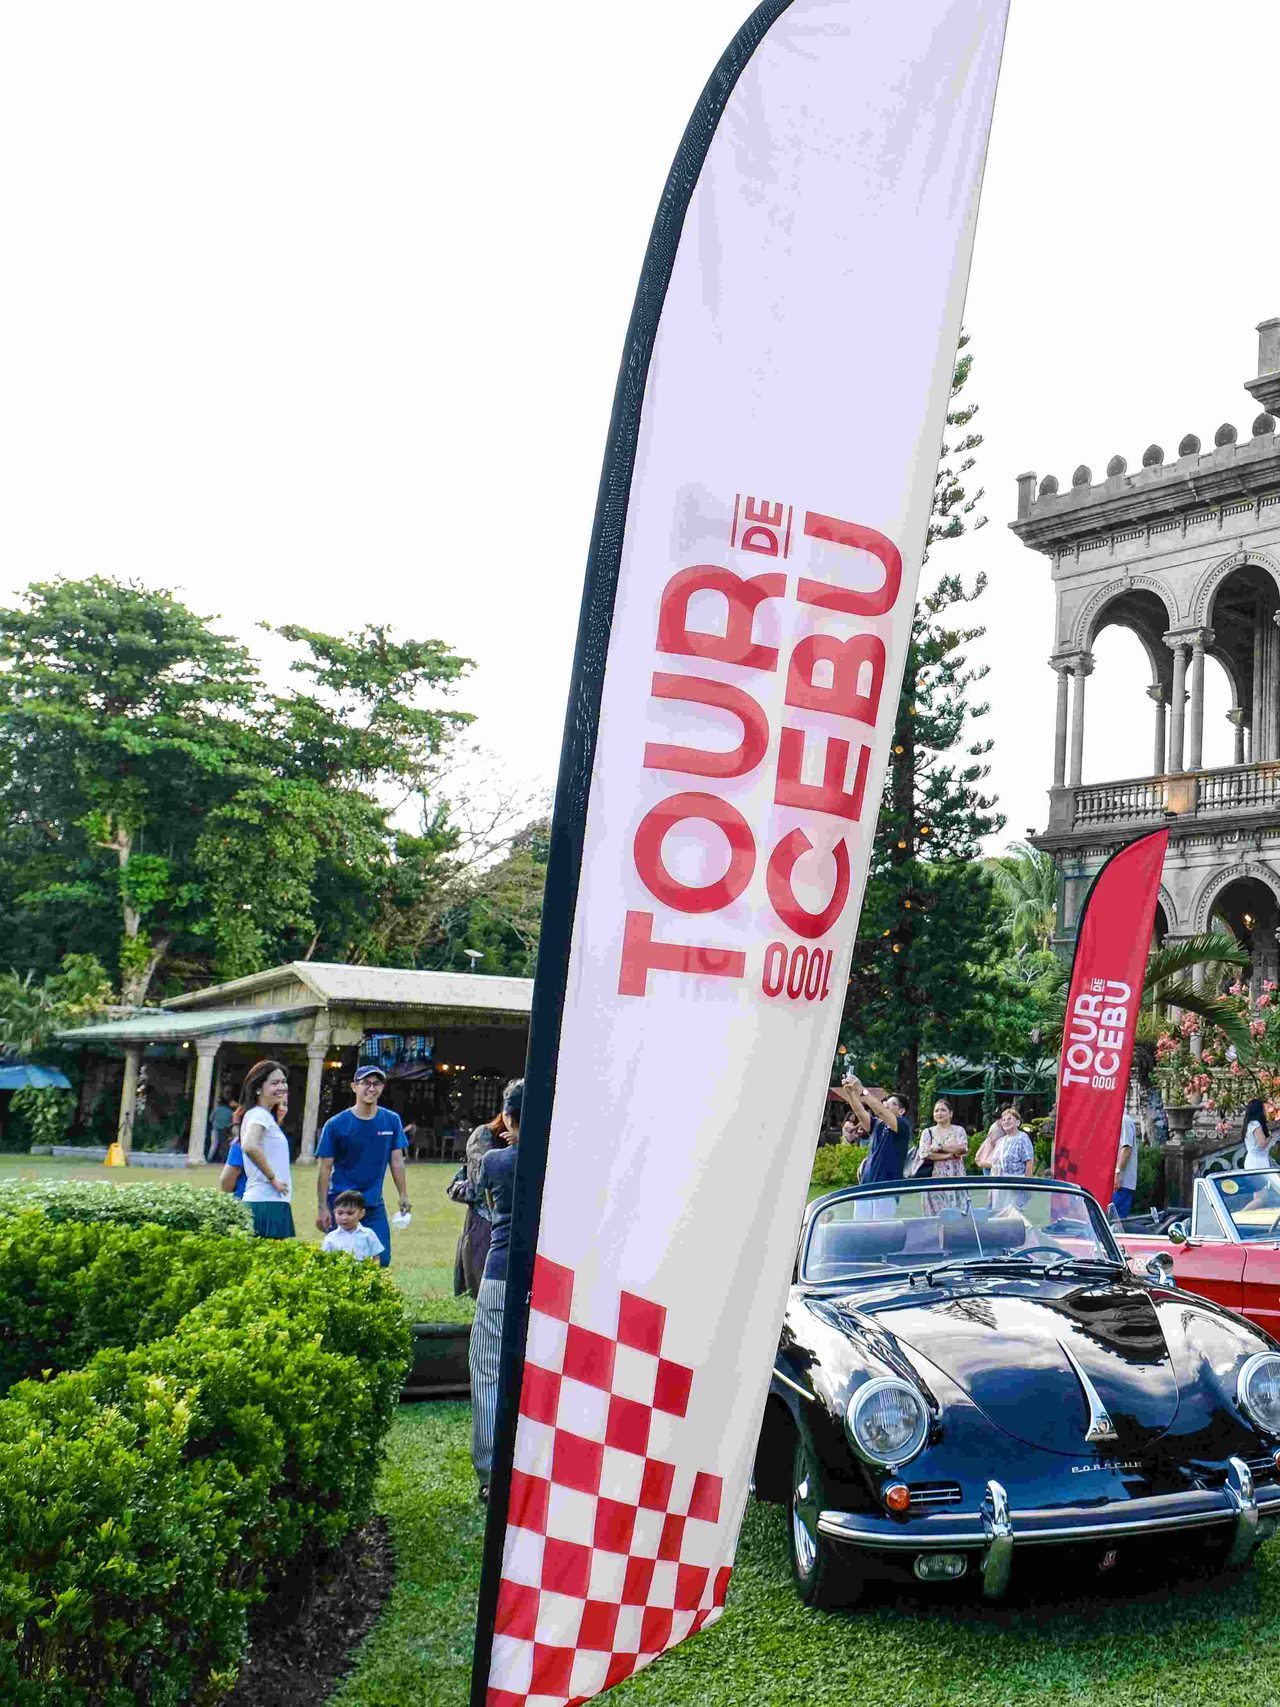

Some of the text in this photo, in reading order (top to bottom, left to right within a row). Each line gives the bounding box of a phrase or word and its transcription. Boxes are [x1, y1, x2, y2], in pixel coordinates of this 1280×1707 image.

[617, 496, 787, 997] TOUR DE
[765, 510, 903, 940] CEBU
[762, 942, 833, 1002] 1000
[1062, 978, 1104, 1088] TOUR DE
[1093, 980, 1132, 1076] CEBU
[1091, 1075, 1116, 1091] 1000
